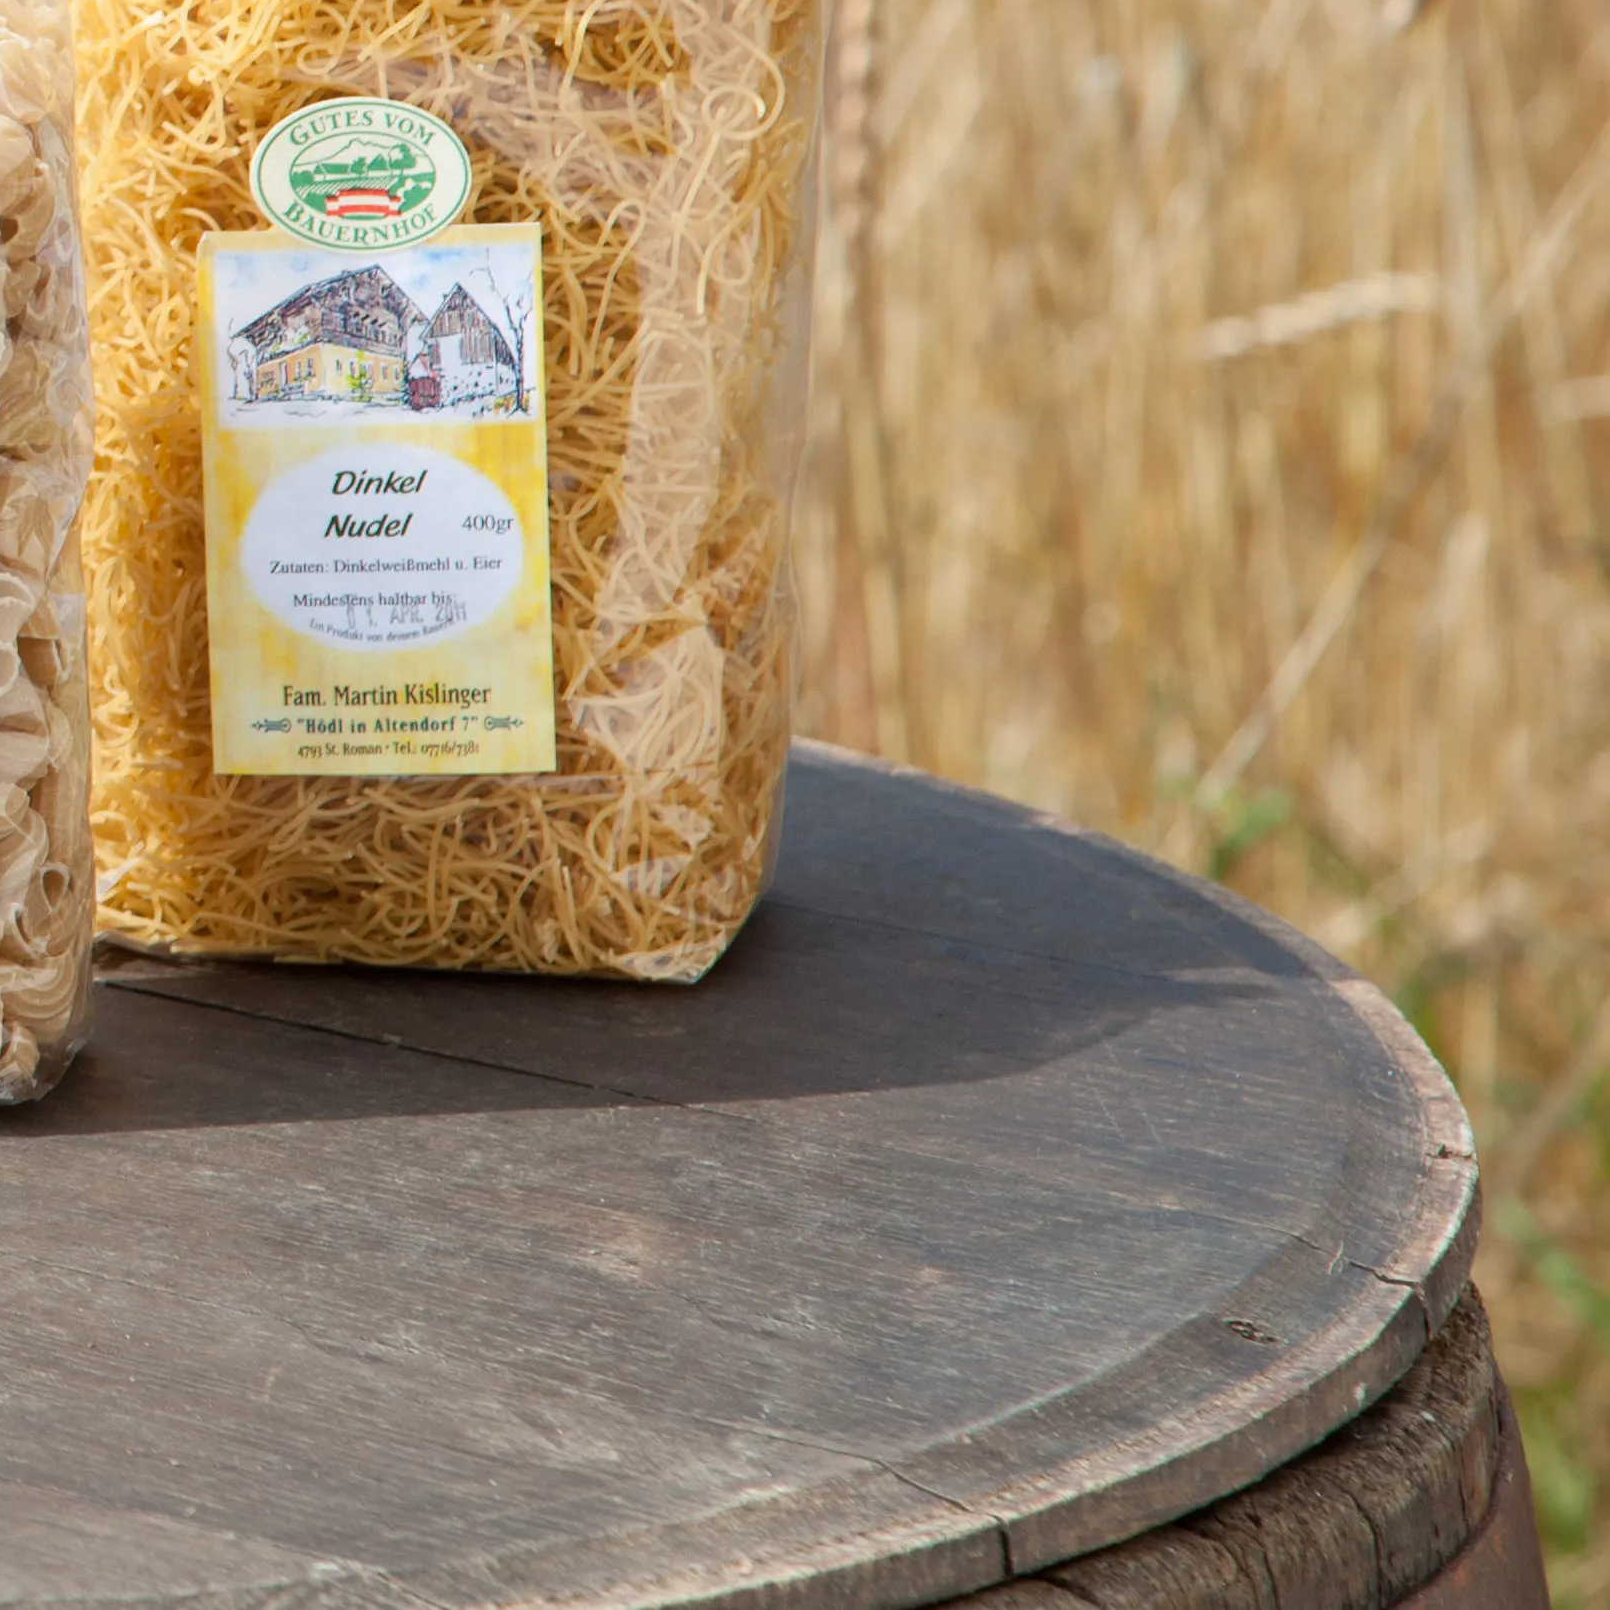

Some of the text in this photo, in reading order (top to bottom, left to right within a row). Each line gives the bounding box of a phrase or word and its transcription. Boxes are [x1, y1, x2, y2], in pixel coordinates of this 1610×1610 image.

[289, 109, 436, 146] GUTES VOM
[282, 199, 438, 246] BAUERNHOF
[331, 469, 428, 495] Dinkel
[324, 513, 514, 538] Nudel 400gr
[270, 556, 502, 574] Zutaten: Dinkelweißmehl u. Eier
[293, 591, 457, 607] Mindestens haltbar bis:
[283, 683, 491, 709] Fam. Martin Kislinger
[351, 720, 366, 733] in
[374, 717, 457, 734] Altendorf
[298, 746, 322, 759] 4793
[325, 743, 340, 756] St.
[343, 743, 382, 755] Roman
[392, 742, 415, 755] Tel.:
